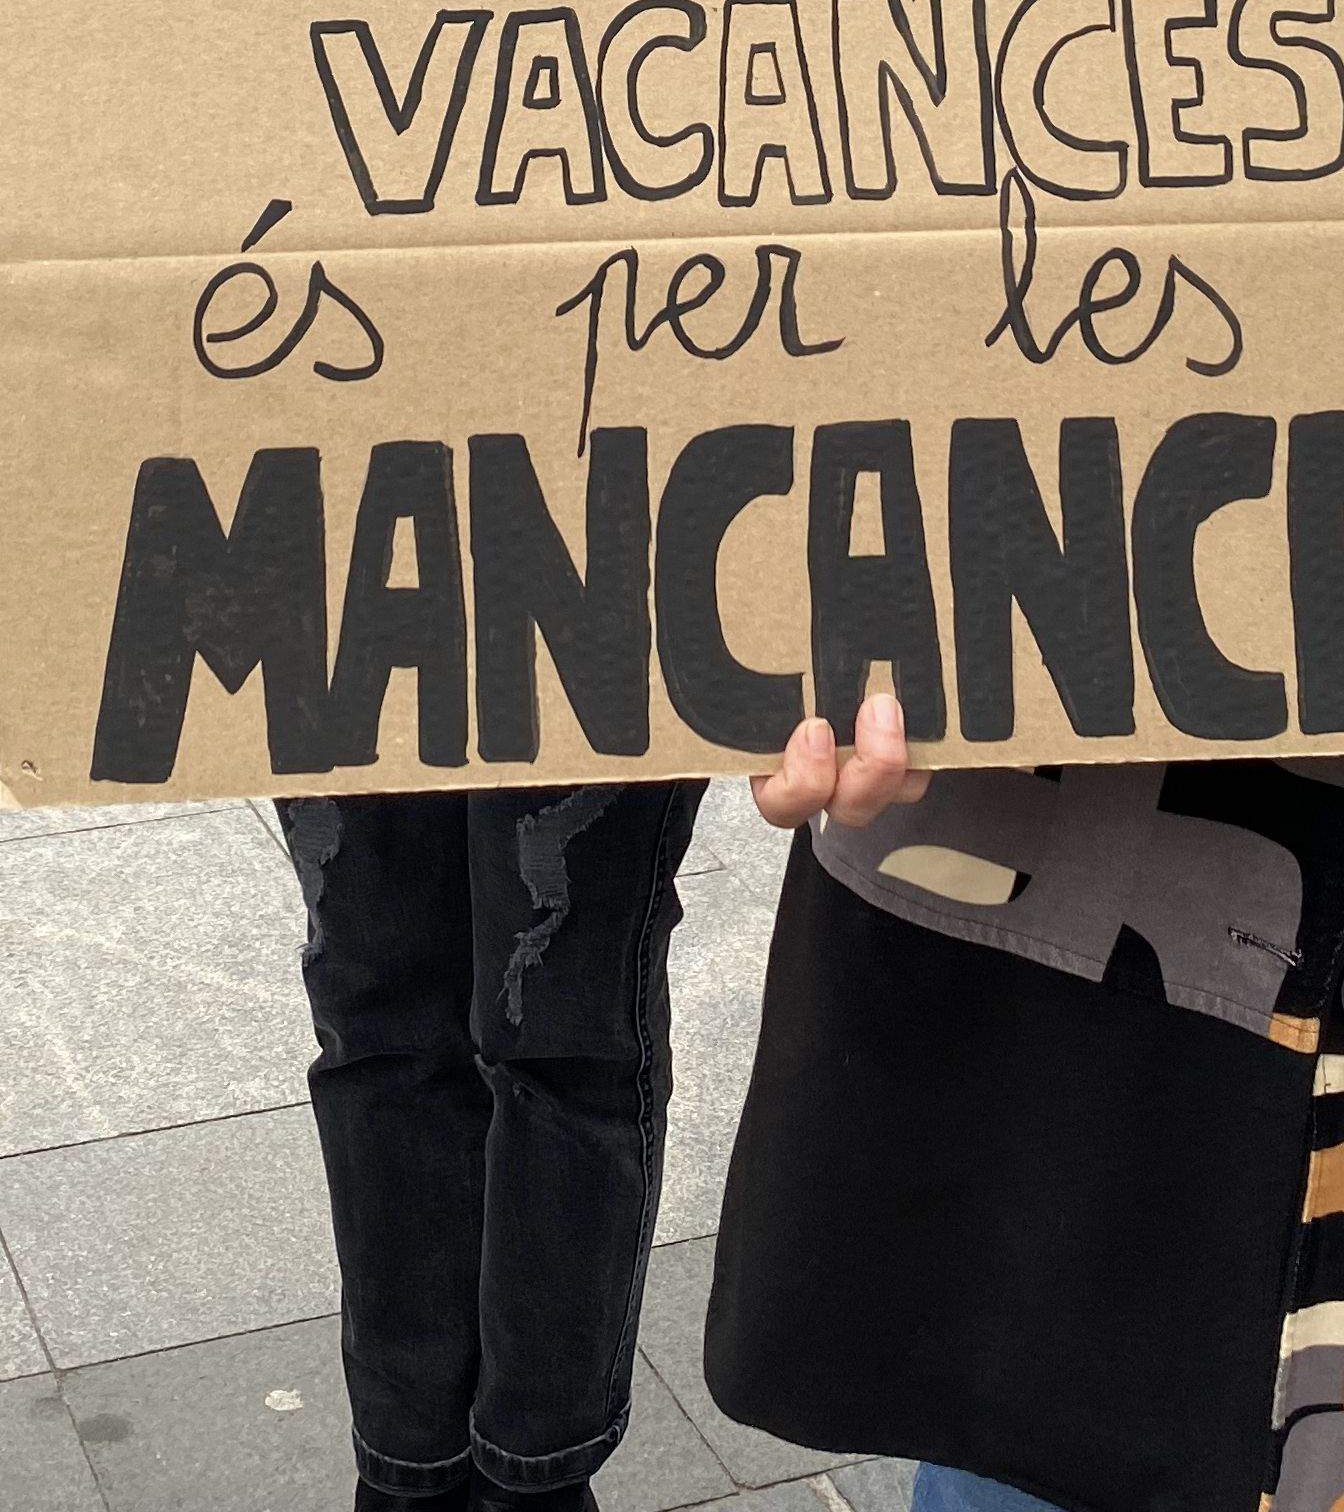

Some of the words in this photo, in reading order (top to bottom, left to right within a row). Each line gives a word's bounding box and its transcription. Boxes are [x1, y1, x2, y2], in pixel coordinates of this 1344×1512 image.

[193, 199, 385, 382] és
[555, 244, 846, 459] per
[984, 168, 1243, 378] les
